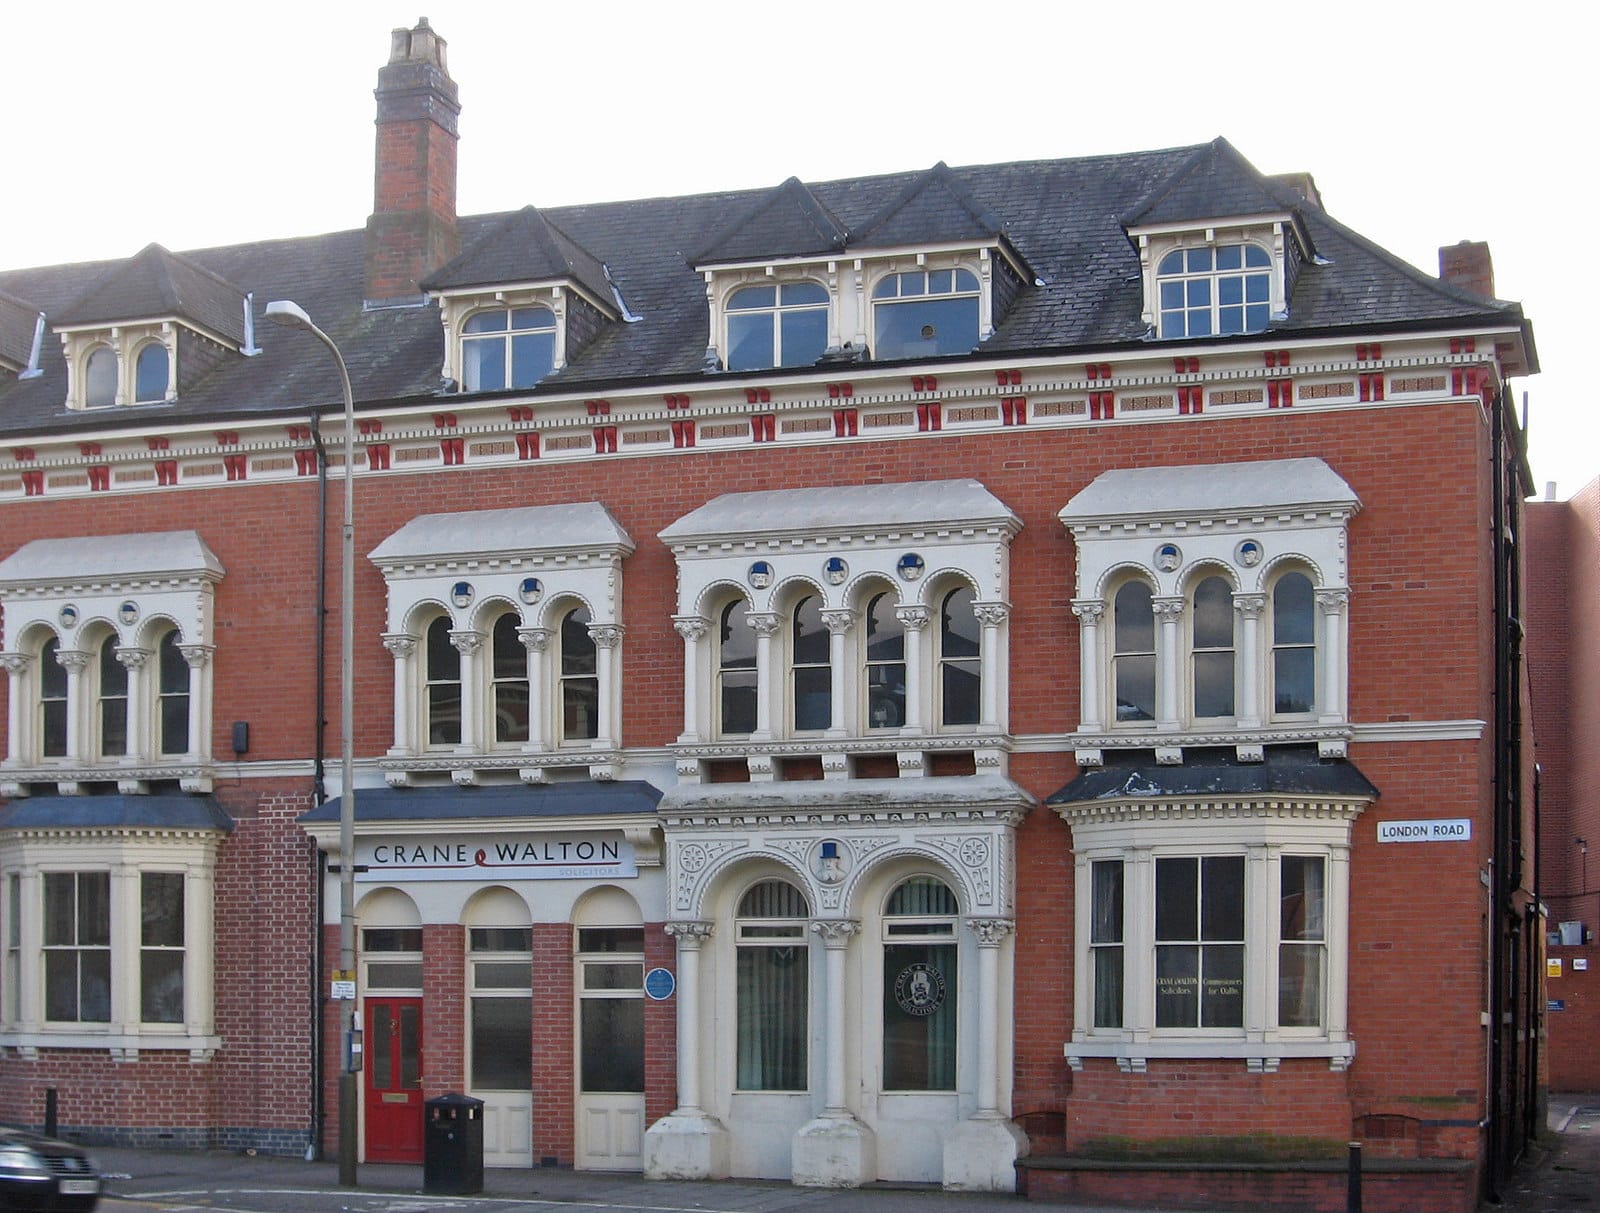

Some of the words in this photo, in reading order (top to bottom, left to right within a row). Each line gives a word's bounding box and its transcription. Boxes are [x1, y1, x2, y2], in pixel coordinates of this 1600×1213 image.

[1382, 826, 1428, 837] LONDON
[1433, 825, 1464, 835] ROAD
[374, 844, 467, 863] CRANE
[495, 841, 618, 861] WALTON
[560, 867, 619, 876] SOLICITORS
